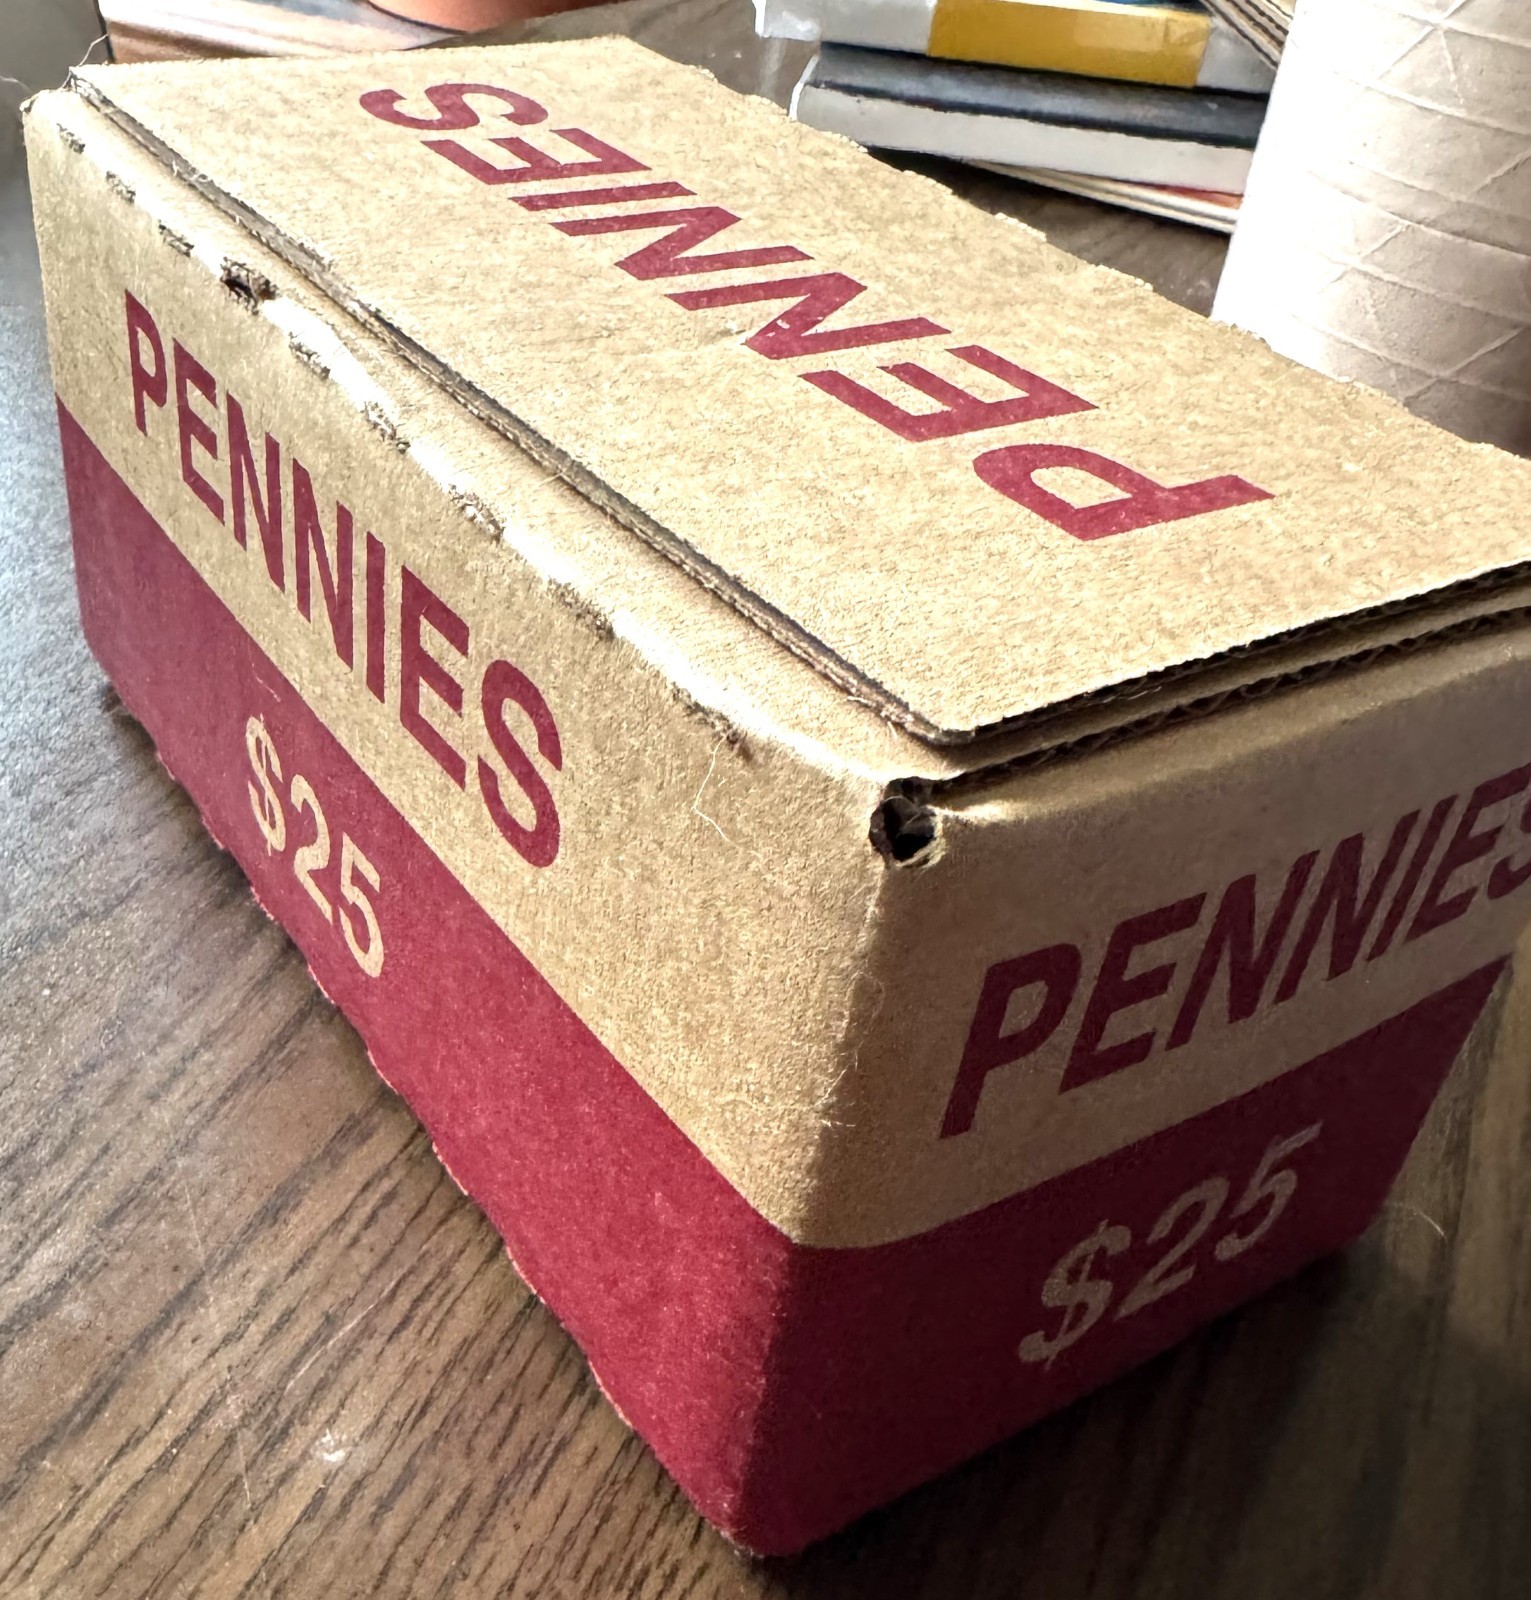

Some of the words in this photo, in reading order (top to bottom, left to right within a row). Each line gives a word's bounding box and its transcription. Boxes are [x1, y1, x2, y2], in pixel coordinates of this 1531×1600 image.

[361, 84, 1274, 541] PENNIES
[125, 292, 563, 867] PENNIES
[245, 713, 385, 978] $25
[1019, 1120, 1323, 1370] $25
